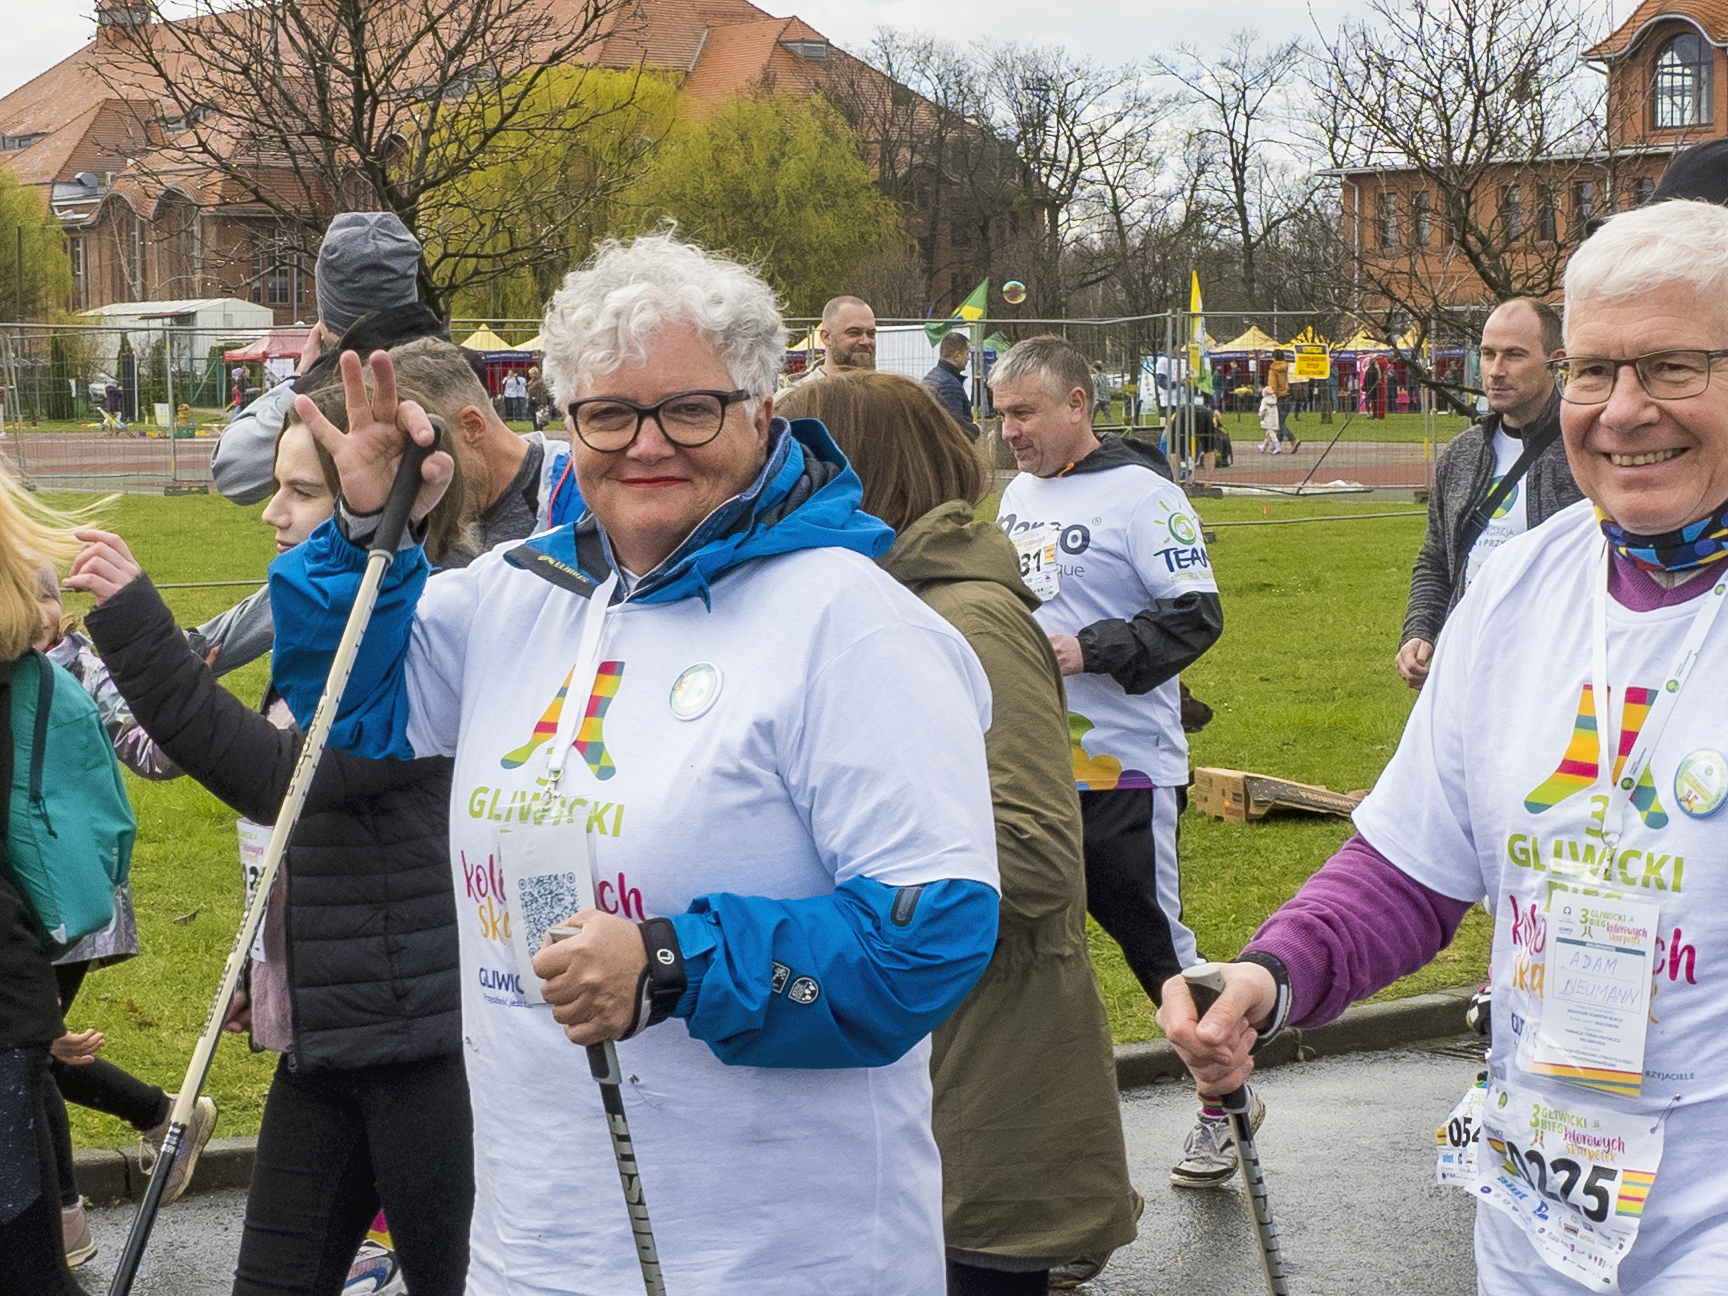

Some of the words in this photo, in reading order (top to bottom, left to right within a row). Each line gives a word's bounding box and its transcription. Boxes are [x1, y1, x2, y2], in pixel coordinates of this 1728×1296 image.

[1020, 549, 1041, 577] 31
[1579, 908, 1589, 925] 3
[1569, 951, 1618, 975] ADAM
[479, 967, 524, 995] GLIWIC
[1561, 977, 1640, 1006] NEUMANN
[1645, 1070, 1694, 1081] RZYJACIELE
[1529, 1103, 1540, 1128] 3
[1541, 1107, 1587, 1128] GLIWICKI
[1540, 1117, 1563, 1134] BIEG
[1562, 1126, 1626, 1154] kolorowych
[1506, 1141, 1618, 1223] 0225
